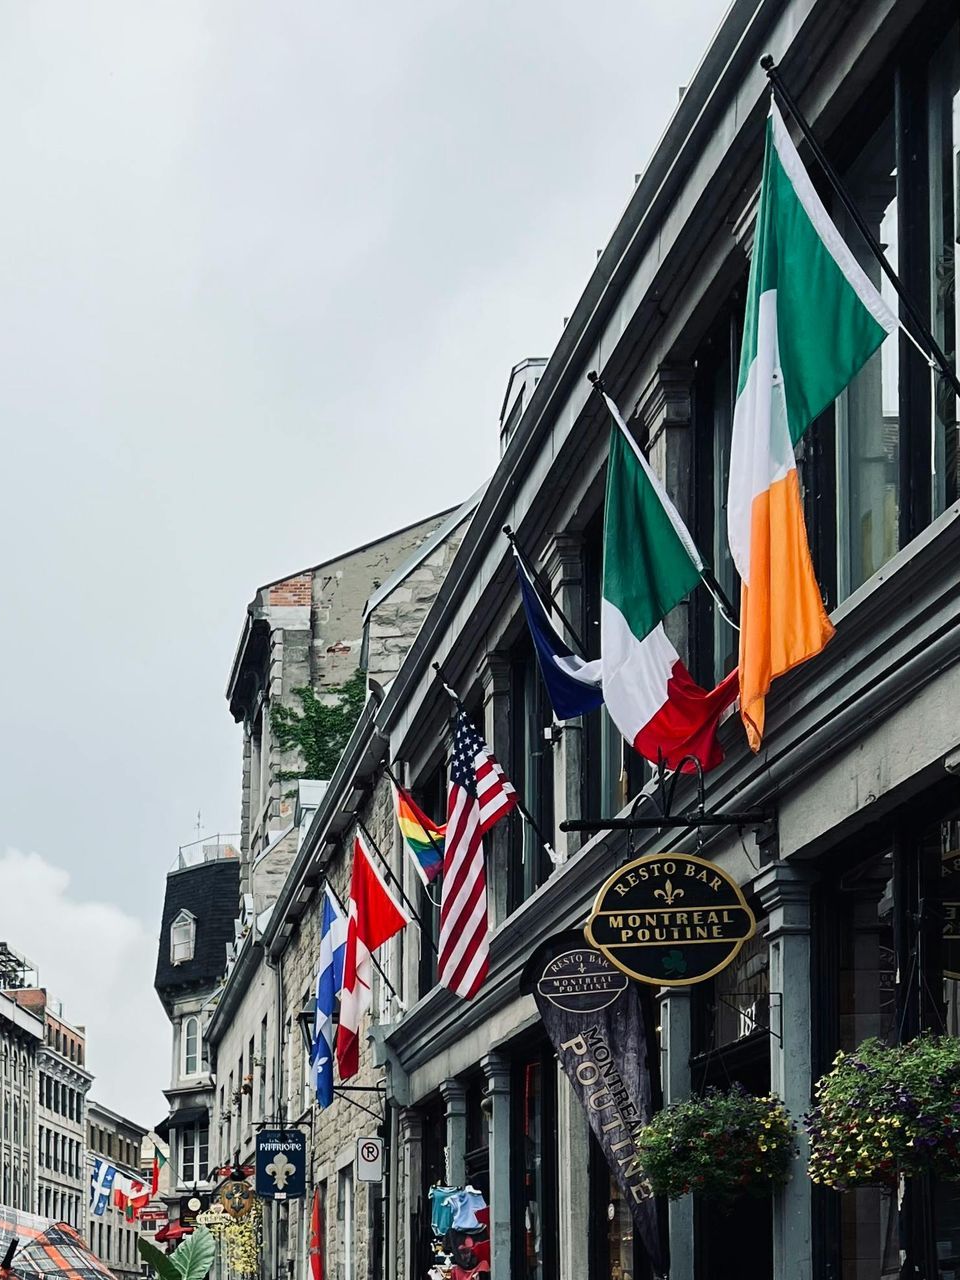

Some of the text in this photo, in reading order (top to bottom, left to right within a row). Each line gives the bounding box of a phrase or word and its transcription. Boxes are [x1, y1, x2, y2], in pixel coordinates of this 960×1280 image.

[613, 861, 722, 897] RESTO BAR
[609, 910, 735, 929] MONTREAL
[621, 925, 724, 943] POUTINE
[550, 954, 609, 973] RESTO BAR
[553, 976, 613, 987] MONTREAL
[559, 982, 609, 993] POUTINE
[739, 1001, 757, 1038] 181
[582, 1025, 643, 1147] MONTREA
[560, 1033, 654, 1205] POUTINE
[259, 1142, 302, 1152] PATRIOTE
